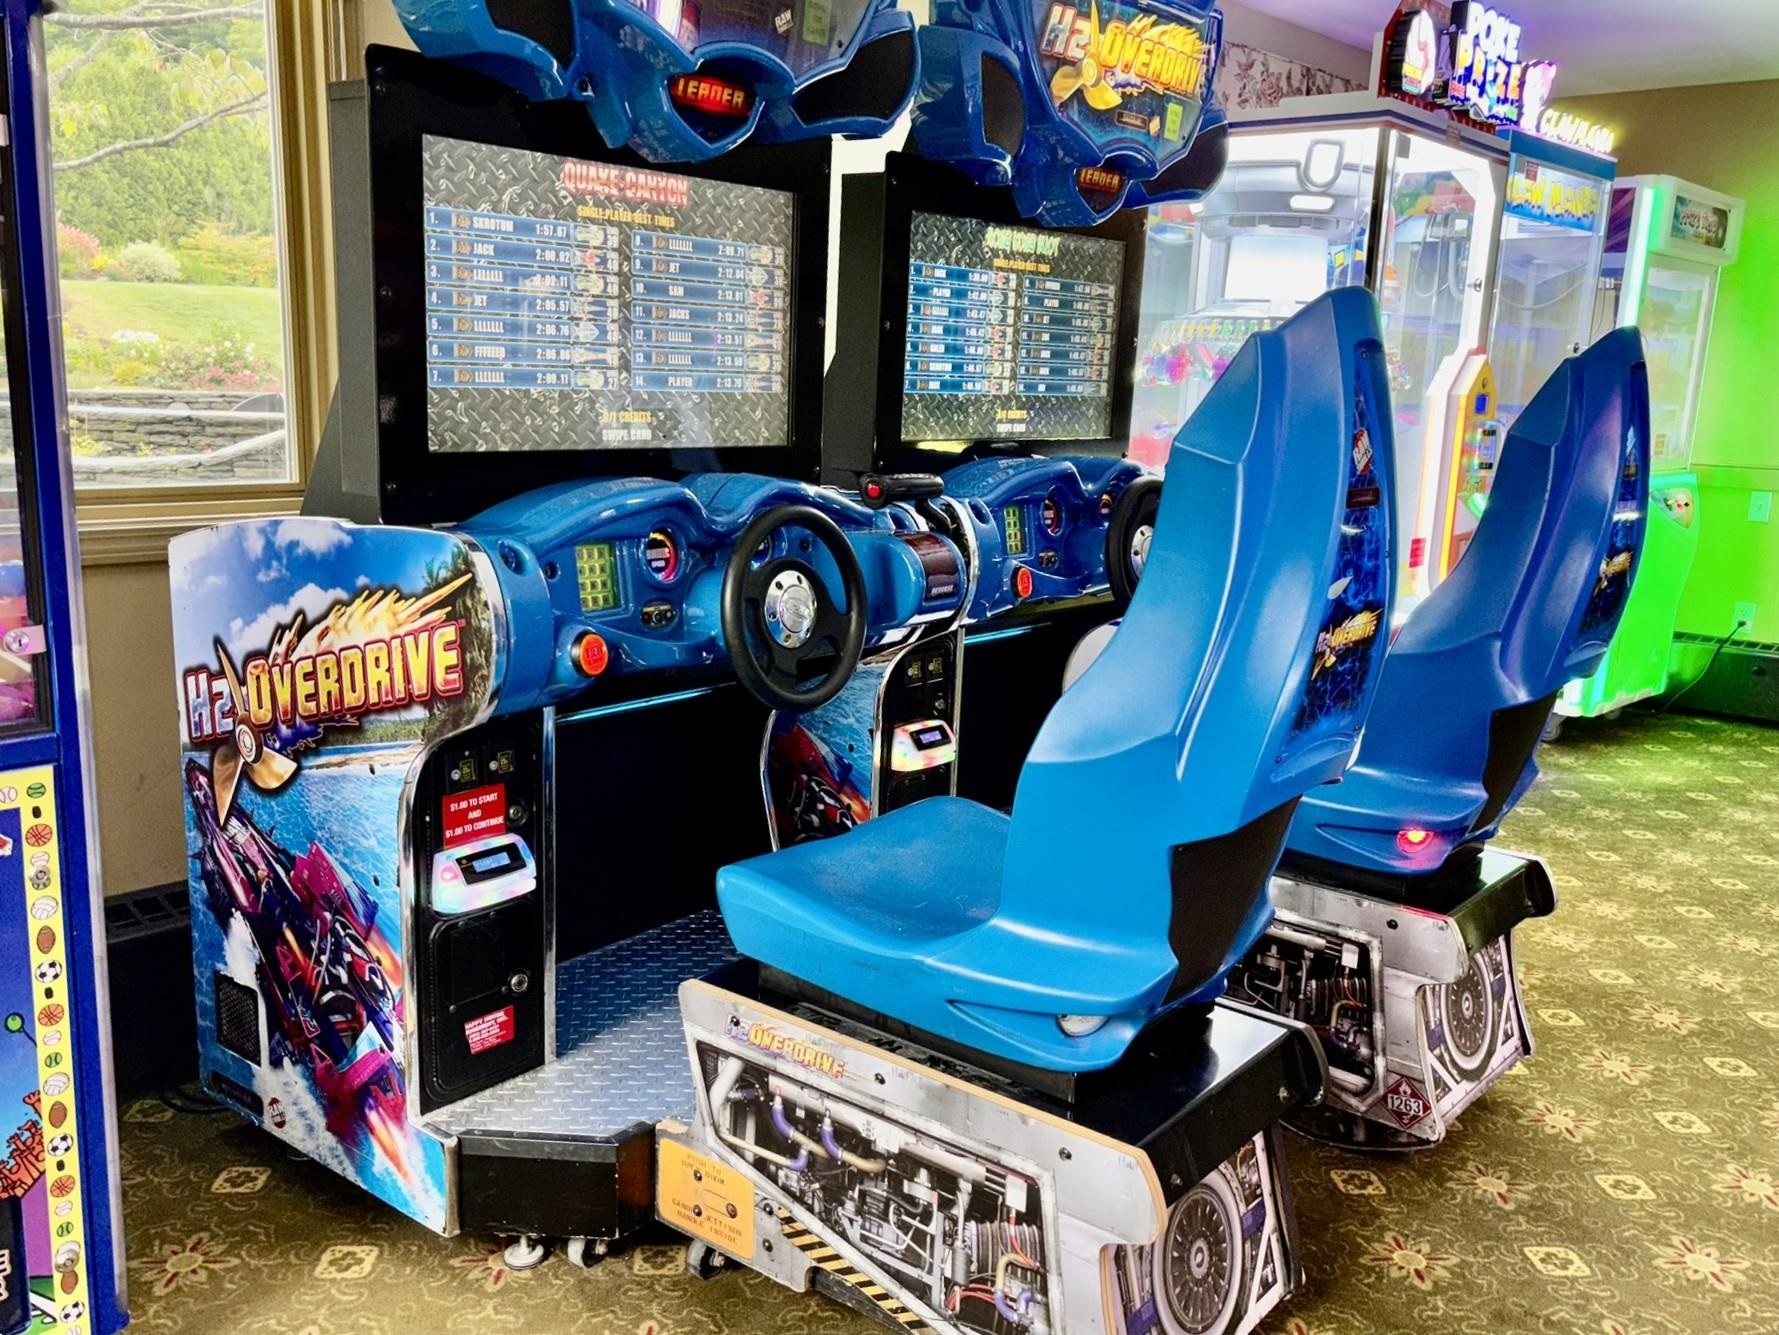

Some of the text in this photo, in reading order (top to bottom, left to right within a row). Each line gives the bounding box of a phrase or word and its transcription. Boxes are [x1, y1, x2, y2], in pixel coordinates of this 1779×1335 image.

[775, 9, 792, 28] RAW
[1467, 1, 1521, 63] POKE
[1042, 5, 1202, 98] H2 OVERDRIV
[564, 162, 688, 206] QUAKE CANYON
[1079, 167, 1121, 189] LEADER
[473, 243, 495, 257] JACK
[668, 376, 693, 388] PLAYER
[246, 624, 464, 727] OVERDRIVE
[450, 792, 498, 812] $1.00 TO START
[467, 809, 482, 820] AND
[445, 815, 504, 838] $1.00 TO CONTINUE
[750, 1024, 846, 1078] OVERDRIVE
[1389, 1095, 1421, 1114] 1263
